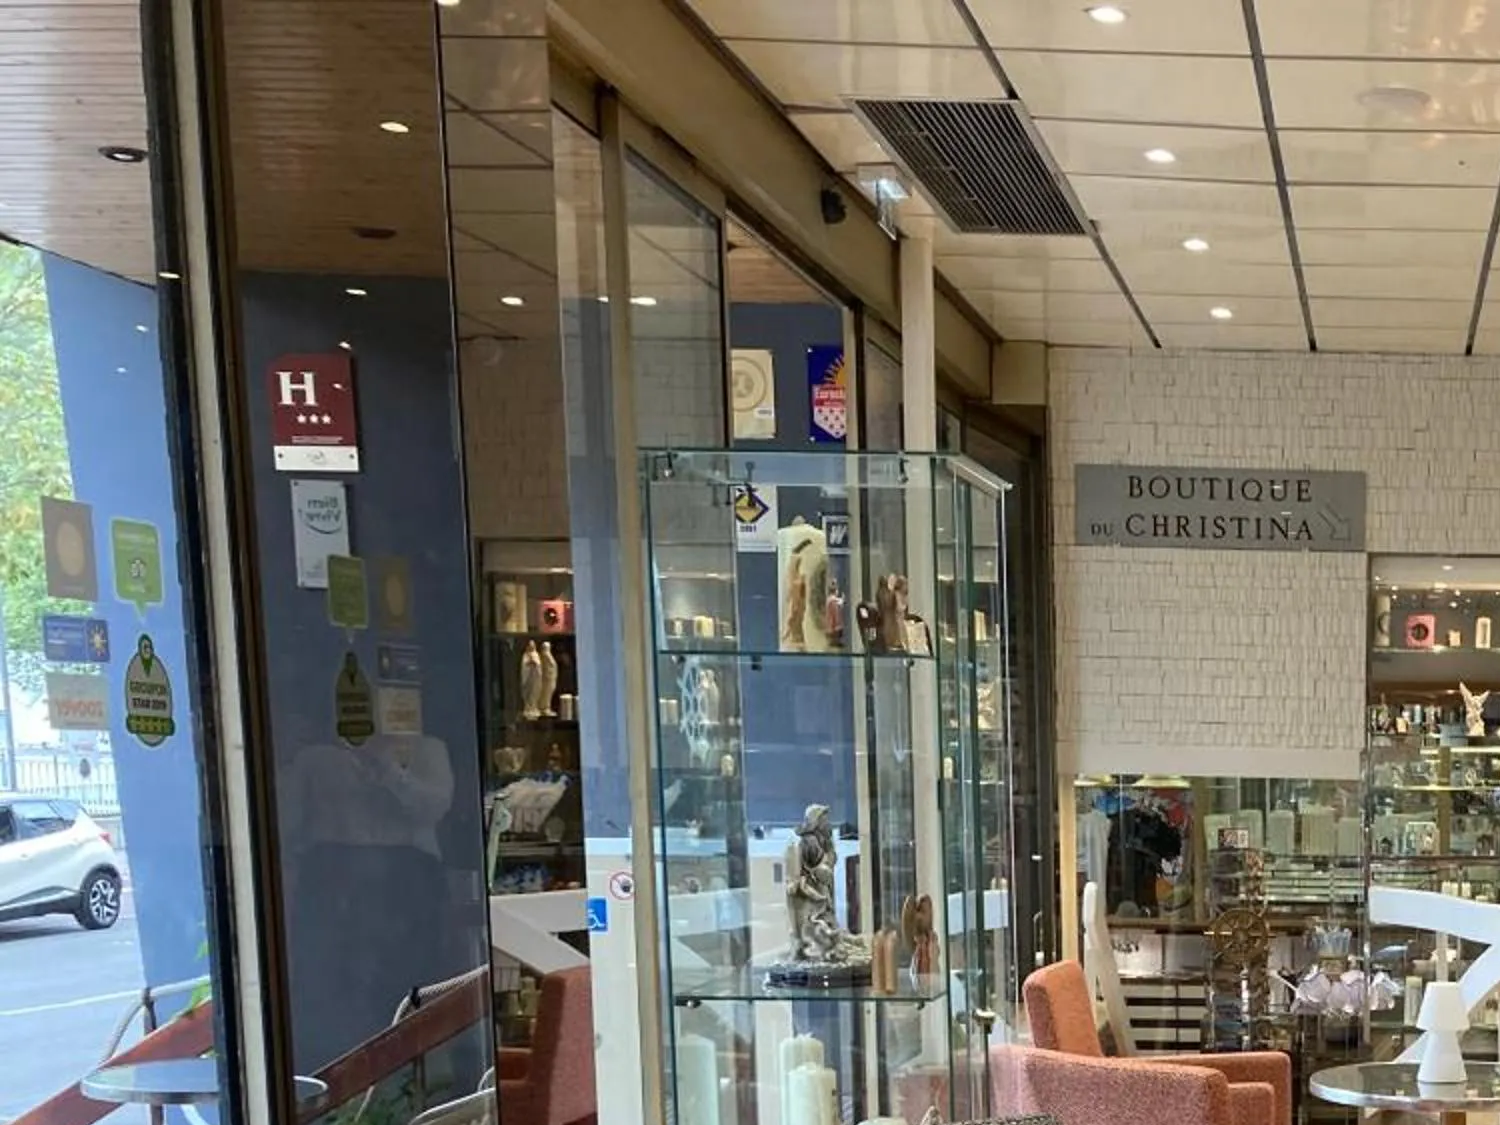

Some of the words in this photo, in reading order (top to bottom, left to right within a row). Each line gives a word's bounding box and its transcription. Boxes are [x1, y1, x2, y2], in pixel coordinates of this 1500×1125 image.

[275, 371, 318, 406] H
[1128, 474, 1312, 502] BOUTIQUE
[1090, 522, 1113, 536] DU
[1125, 513, 1313, 541] CHRISTINA
